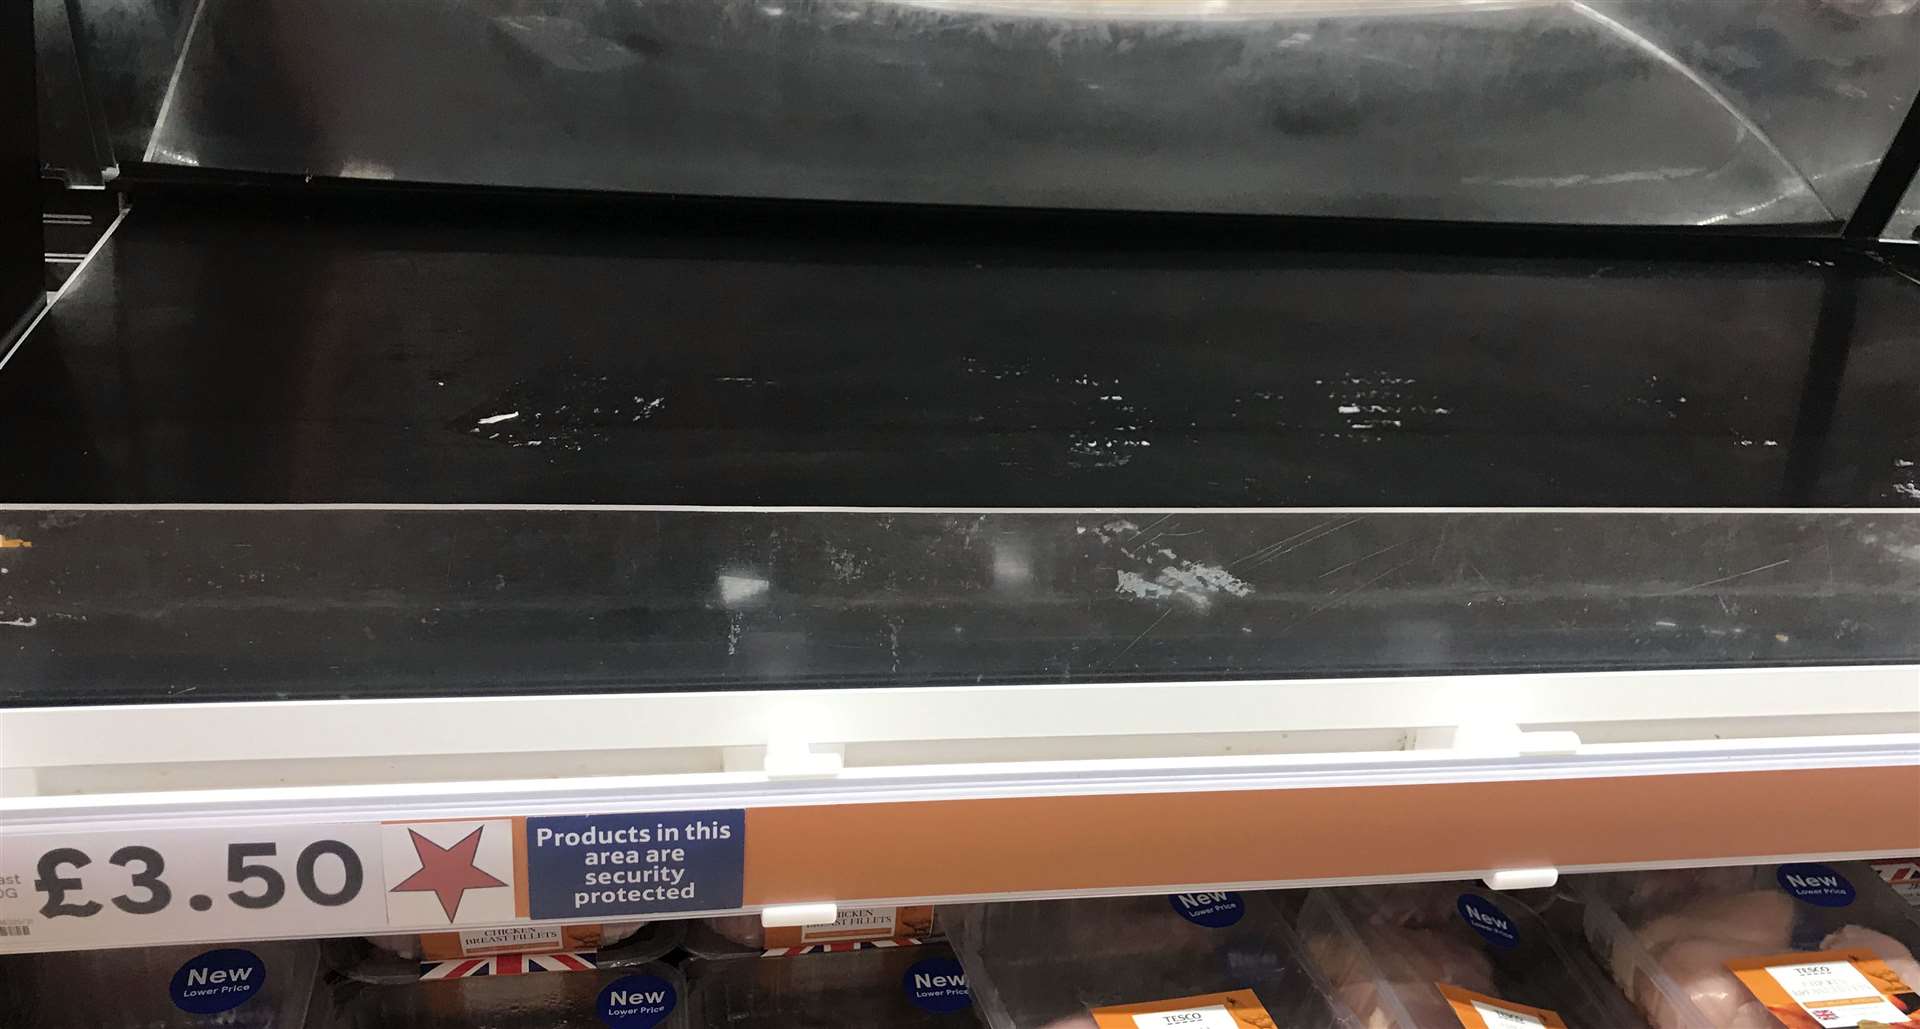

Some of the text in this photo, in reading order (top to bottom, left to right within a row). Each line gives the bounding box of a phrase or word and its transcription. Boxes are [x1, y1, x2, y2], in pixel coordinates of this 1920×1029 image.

[536, 821, 731, 847] Products in this
[584, 848, 685, 866] area are
[34, 839, 364, 919] £3.50
[584, 865, 685, 885] security
[1786, 874, 1838, 887] New
[574, 883, 695, 909] protected
[1178, 892, 1228, 908] New
[1188, 903, 1237, 918] Lower Price
[1465, 904, 1508, 930] New
[465, 932, 557, 945] BREAST FILLETS
[484, 927, 536, 937] CHICKEN
[187, 967, 253, 986] New
[914, 973, 967, 989] New
[183, 984, 250, 998] Lower Price
[610, 990, 665, 1006] New
[640, 1006, 665, 1014] Price
[1163, 1012, 1202, 1022] TESCO
